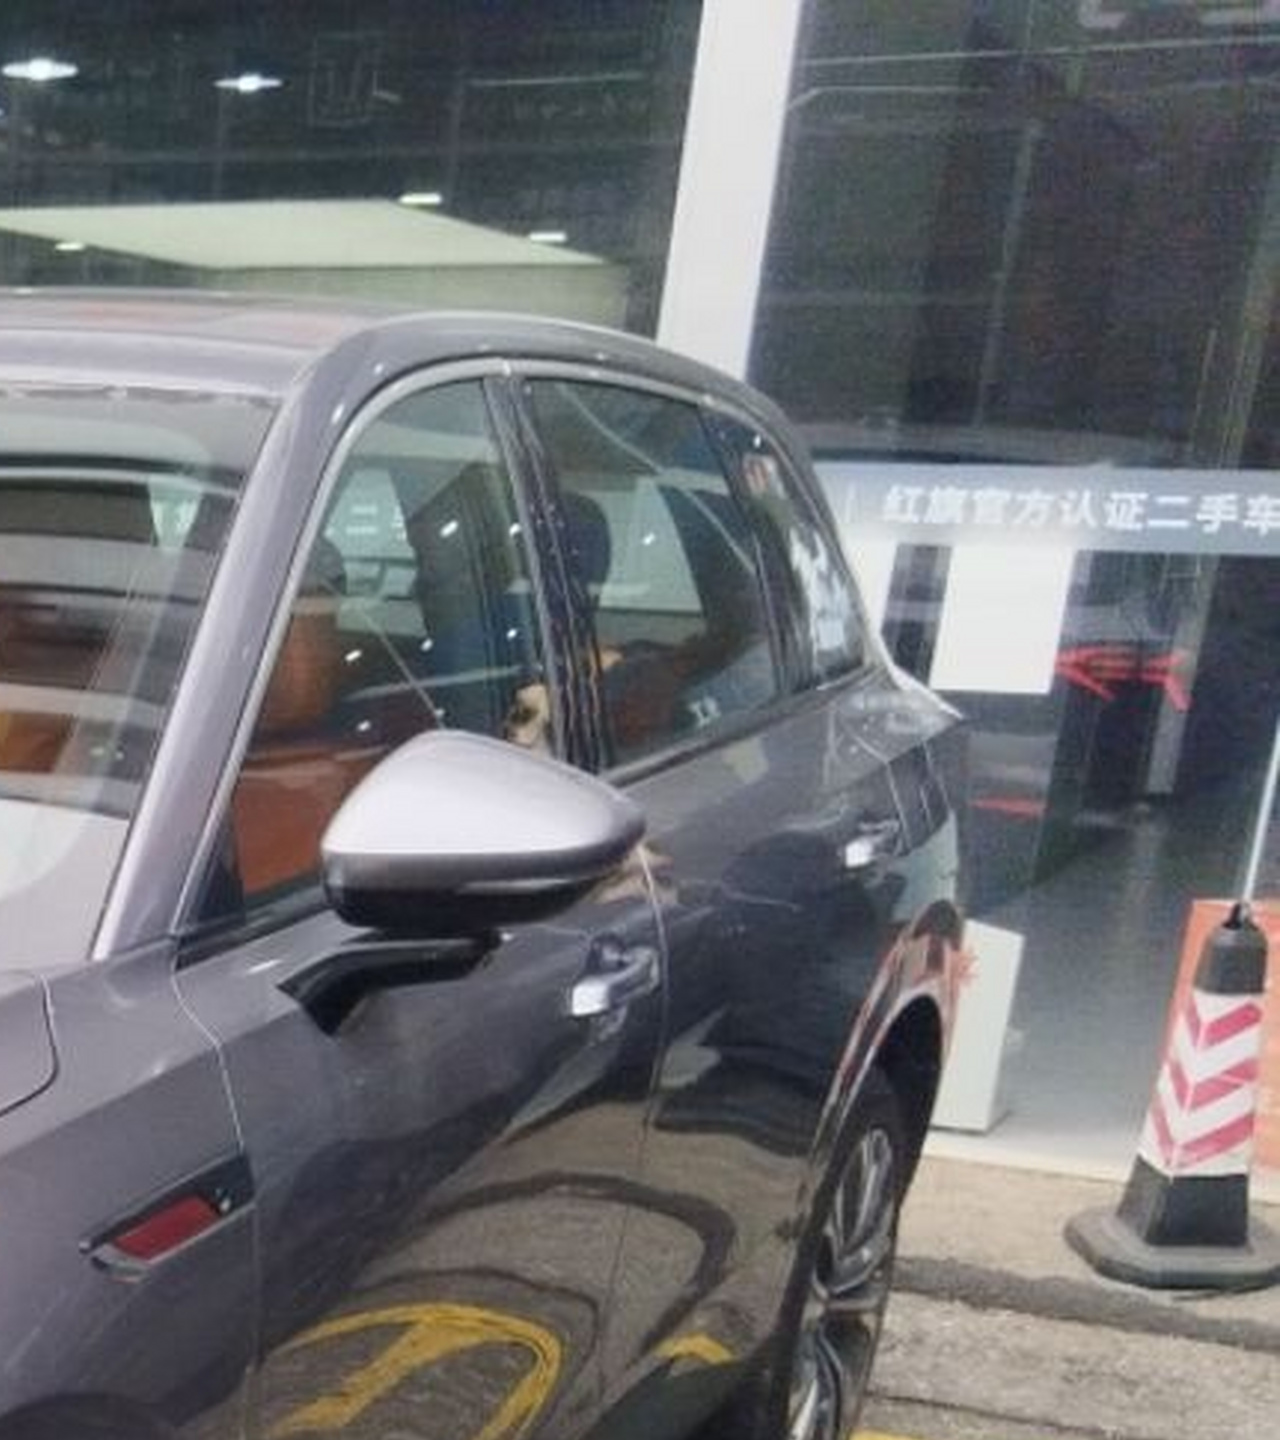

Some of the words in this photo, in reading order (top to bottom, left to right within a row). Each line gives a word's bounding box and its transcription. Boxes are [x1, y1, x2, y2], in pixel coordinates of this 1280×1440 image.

[883, 484, 1280, 536] 红旗官方认证二手车
